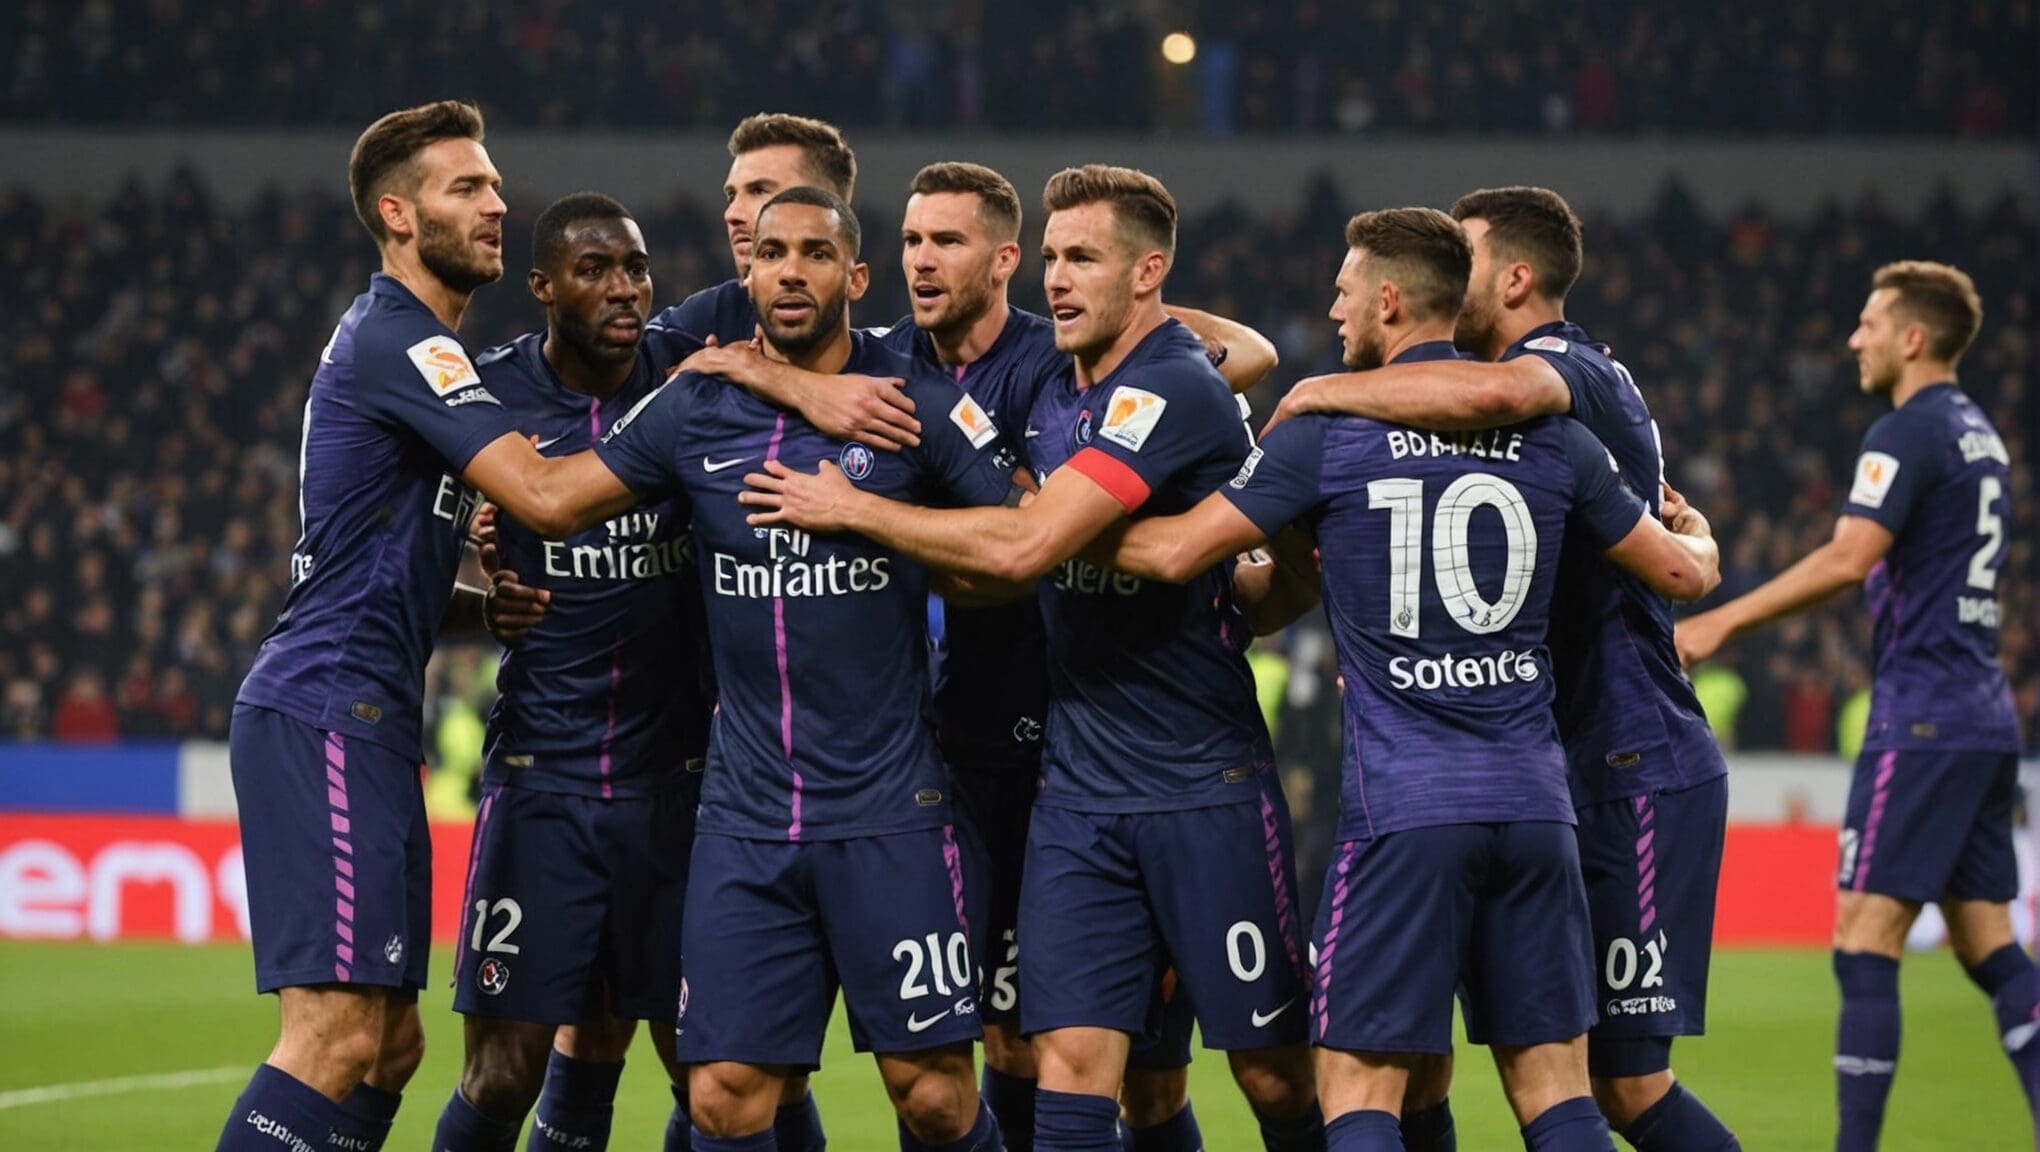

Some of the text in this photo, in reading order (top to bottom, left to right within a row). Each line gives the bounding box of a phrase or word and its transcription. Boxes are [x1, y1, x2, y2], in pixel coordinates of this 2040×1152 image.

[1367, 473, 1538, 639] 10
[471, 897, 523, 956] 12
[1225, 920, 1267, 983] 0
[978, 965, 1017, 1011] 5
